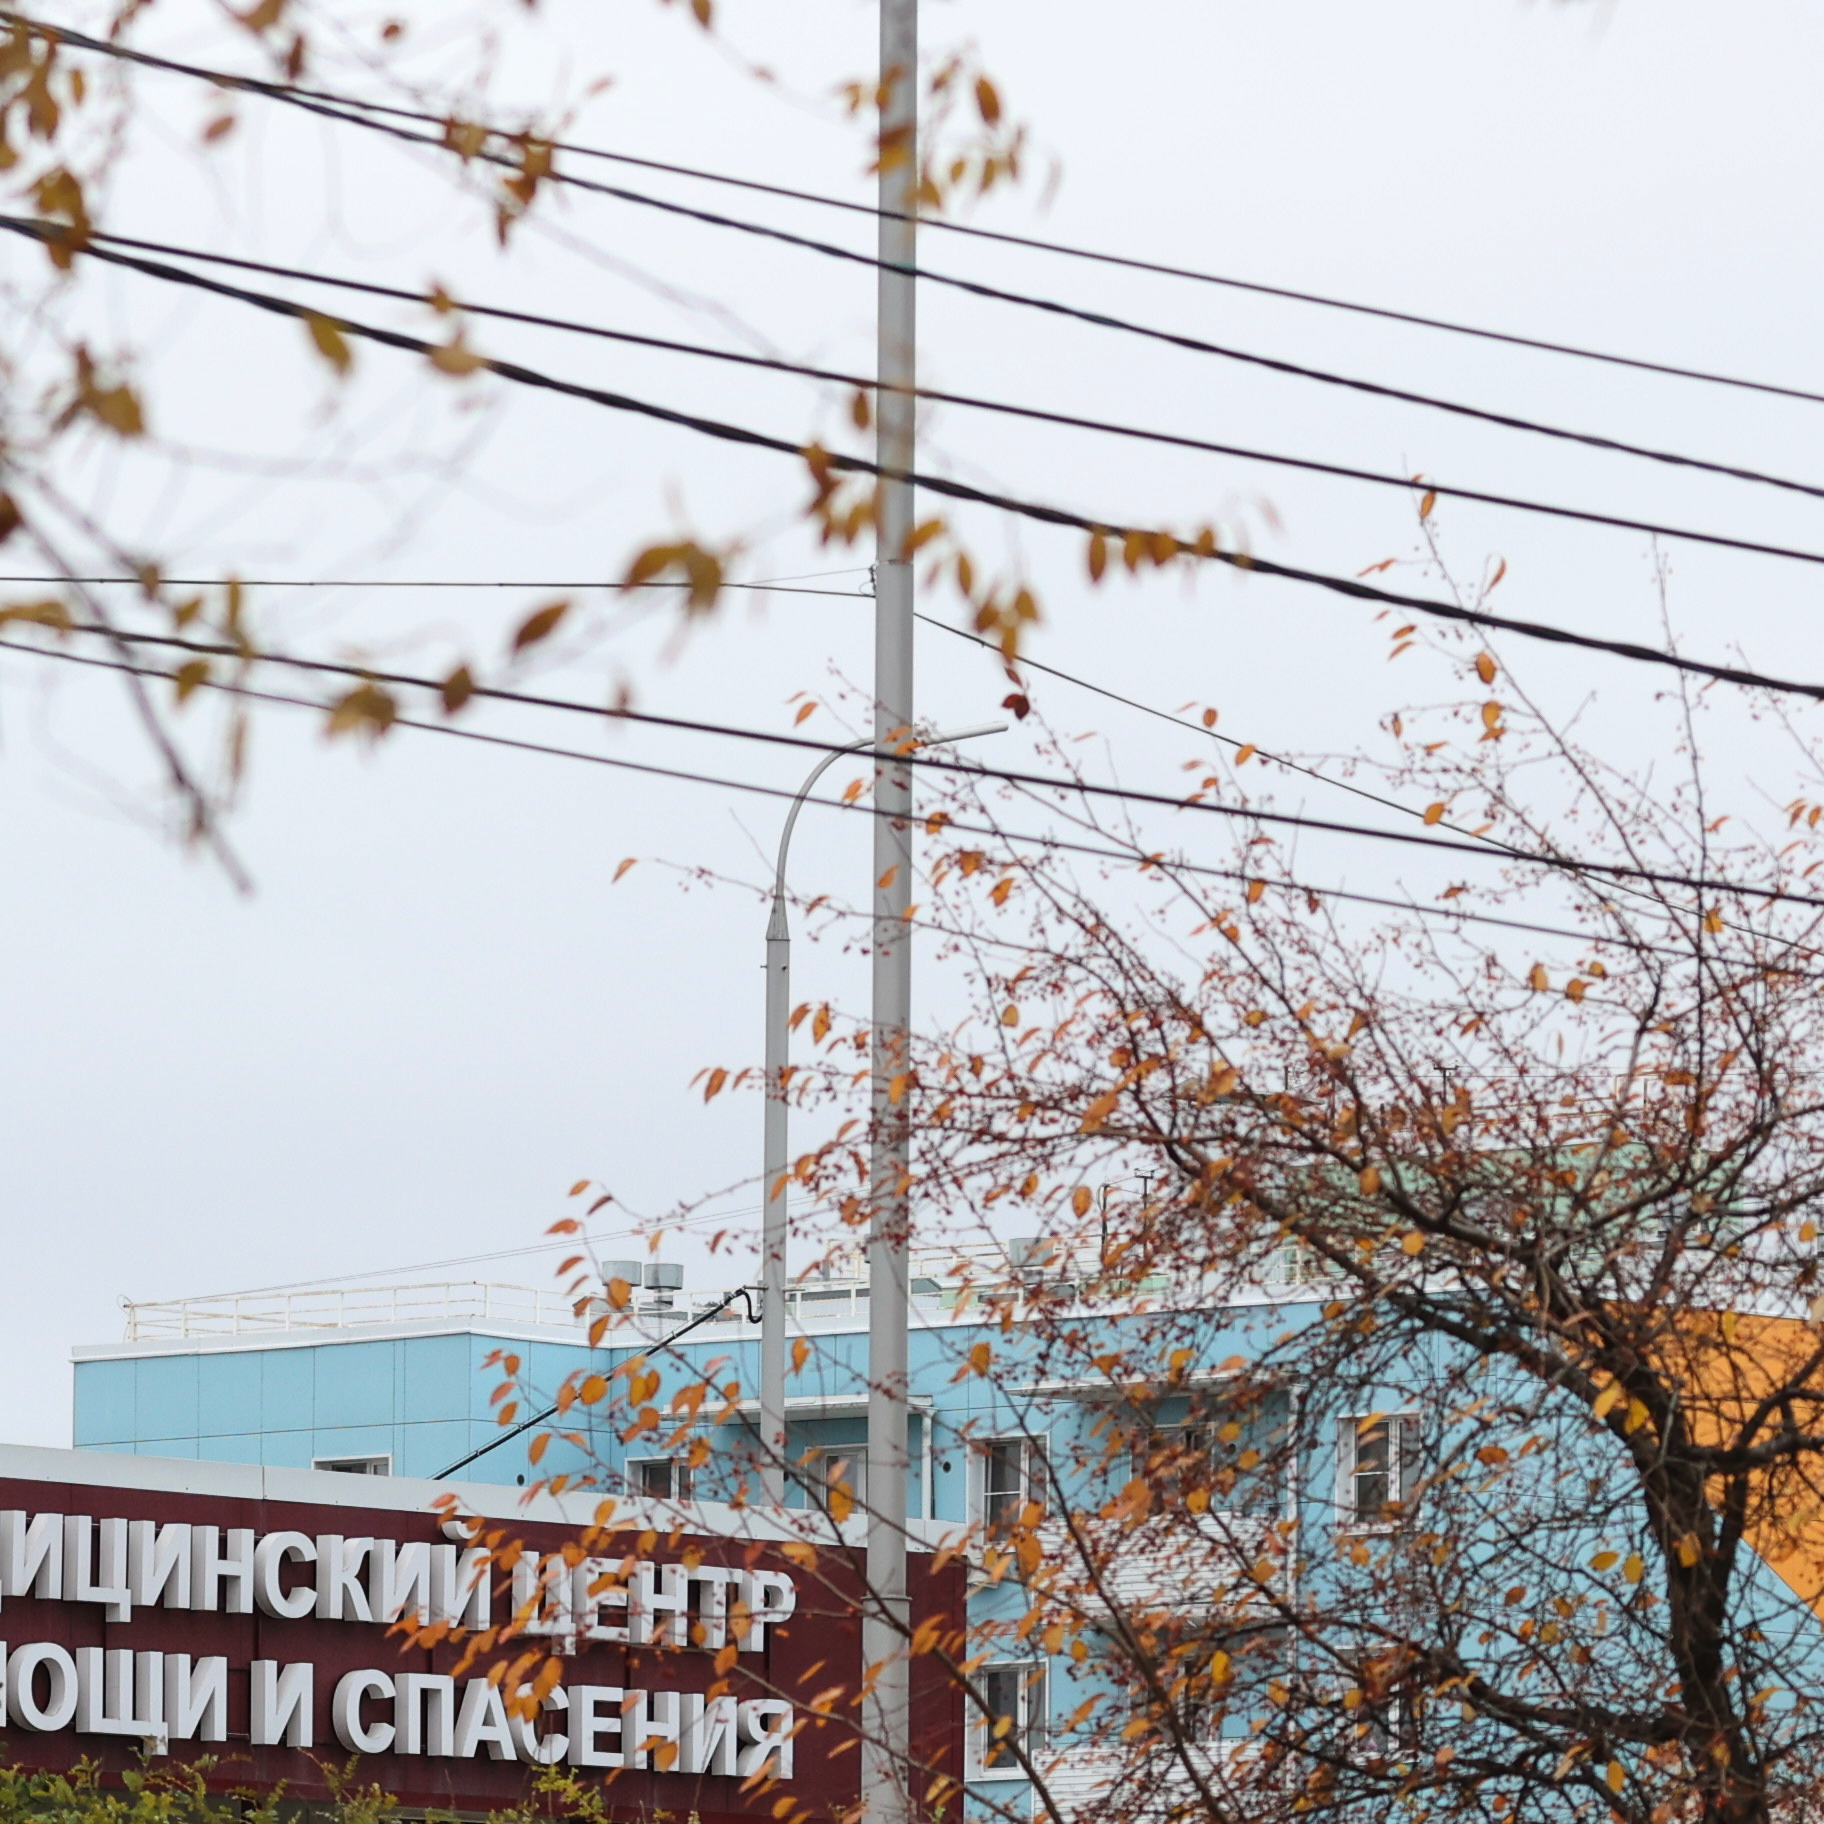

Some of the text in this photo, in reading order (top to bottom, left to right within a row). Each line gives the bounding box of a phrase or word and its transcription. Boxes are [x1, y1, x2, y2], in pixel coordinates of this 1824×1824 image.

[512, 1551, 797, 1656] ЦЕНТР
[250, 1660, 314, 1748] И
[333, 1669, 794, 1779] СПАСЕНИЯ
